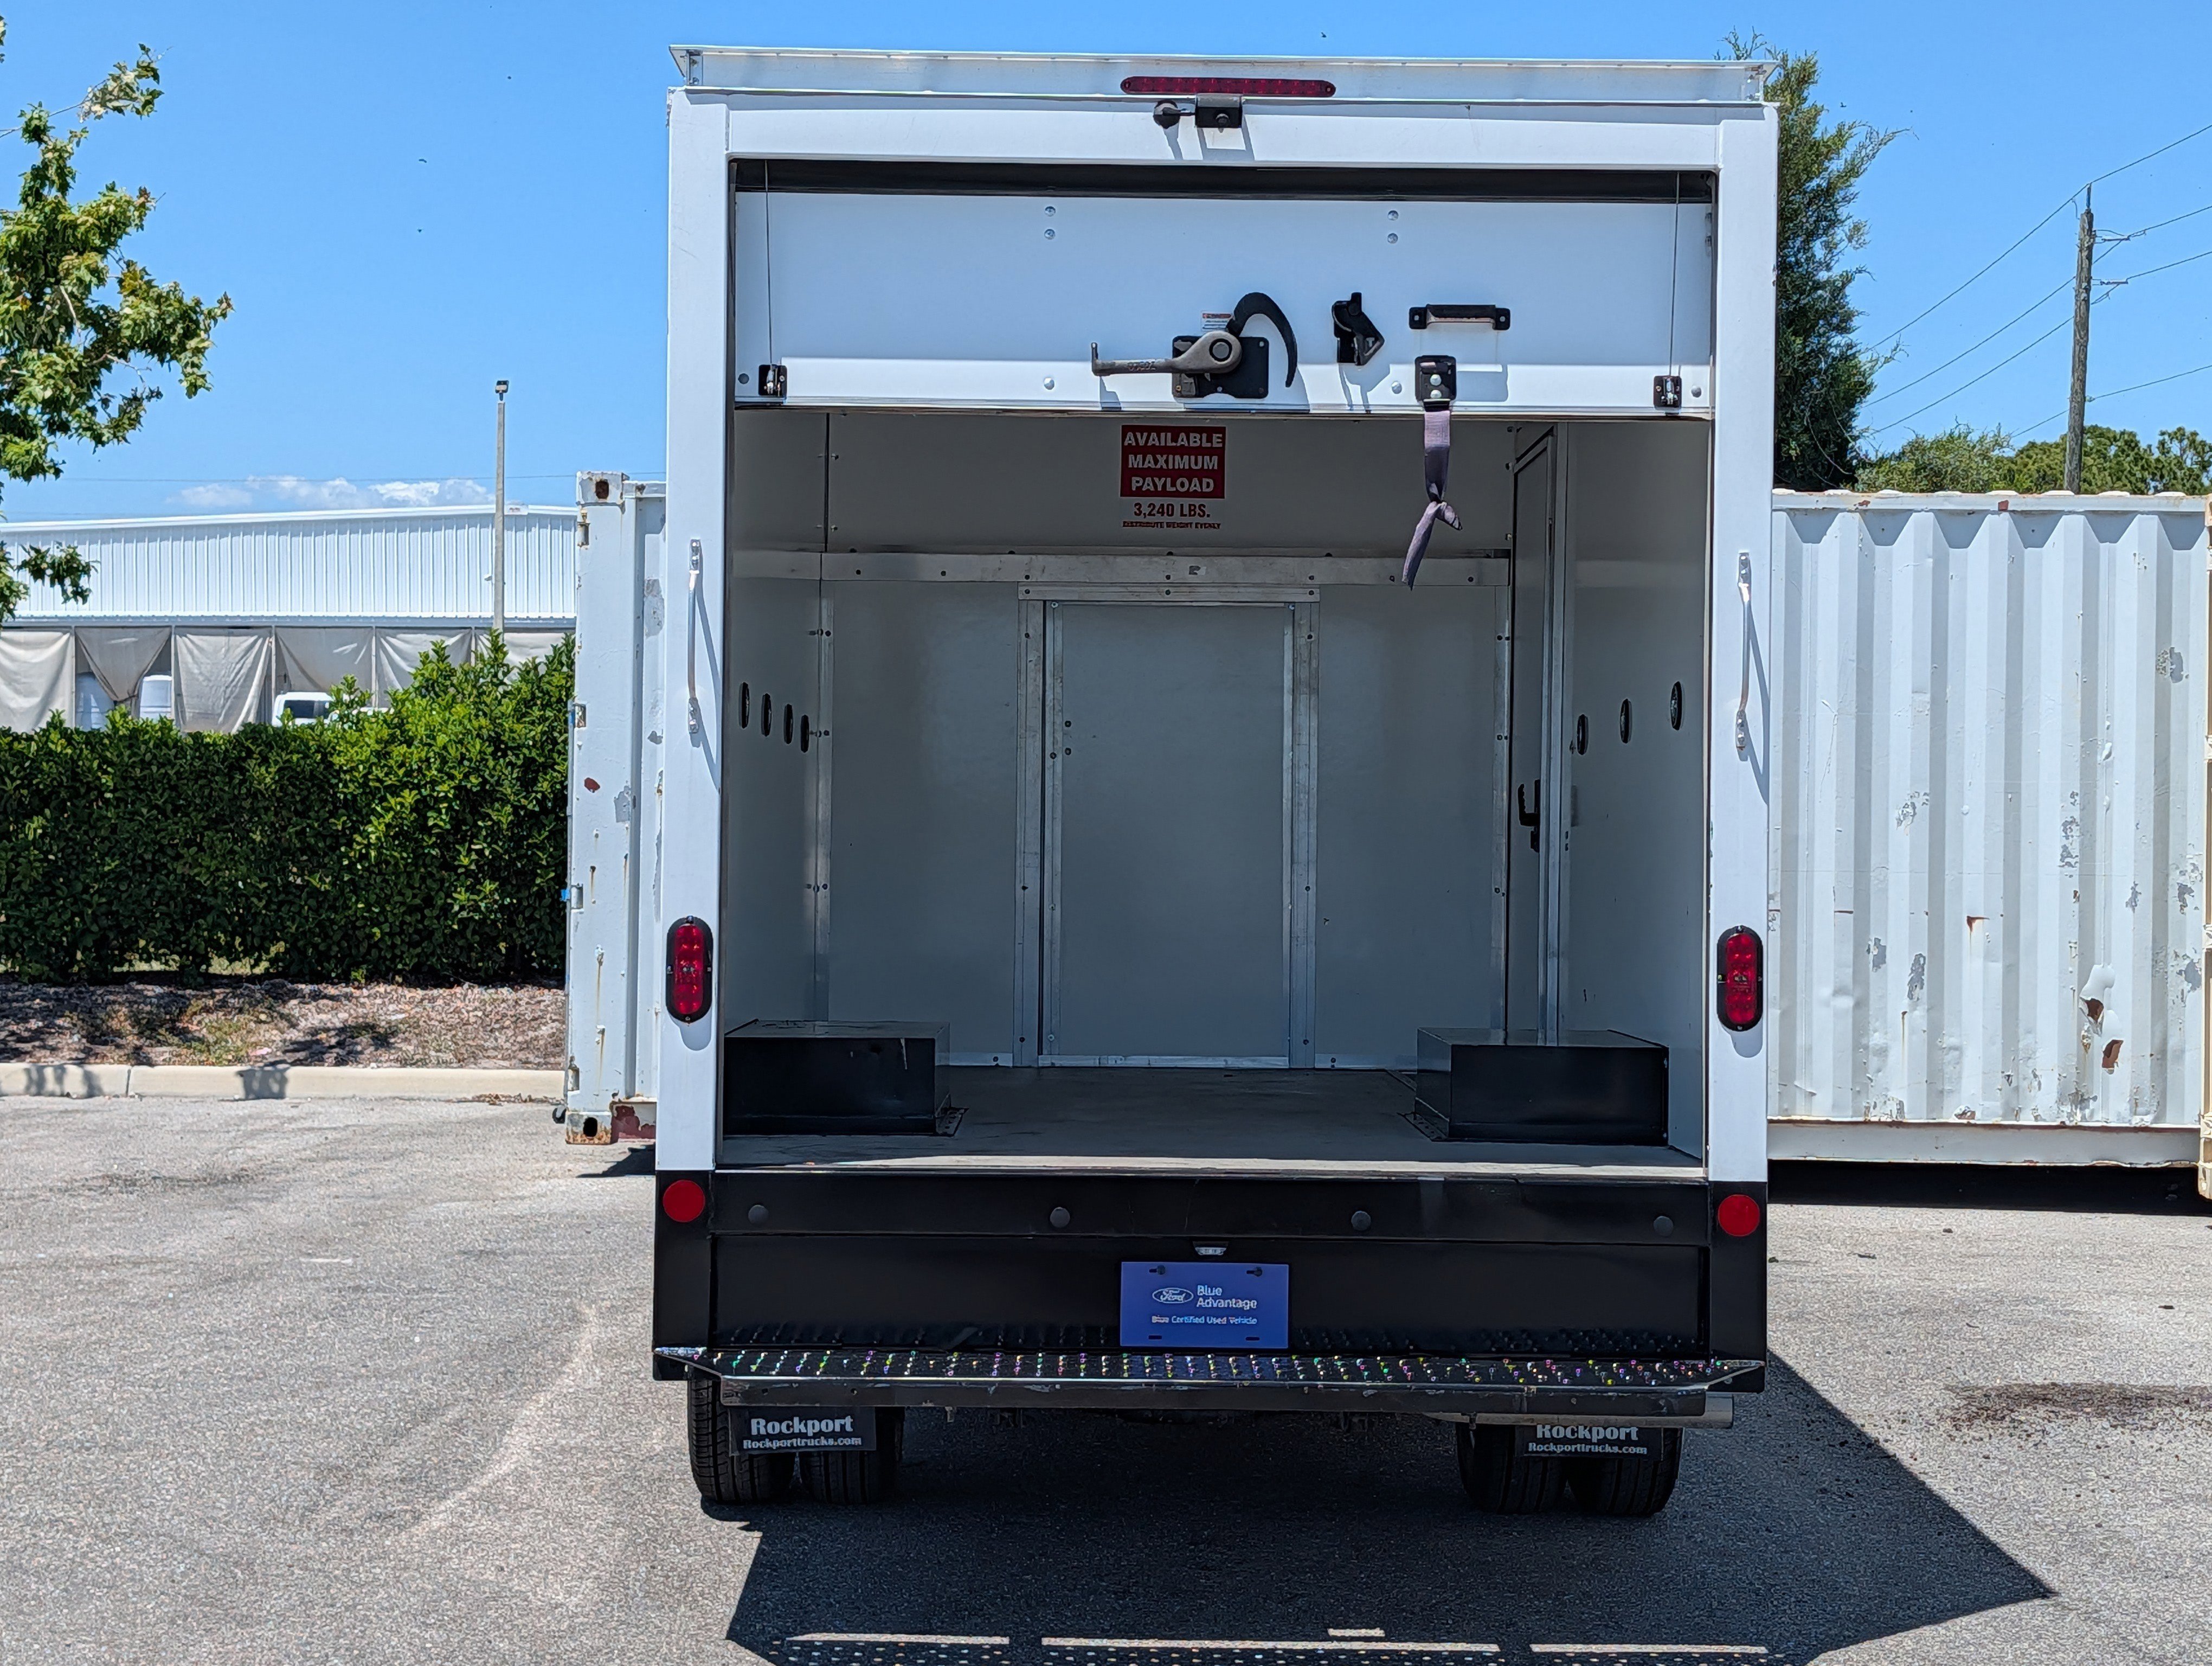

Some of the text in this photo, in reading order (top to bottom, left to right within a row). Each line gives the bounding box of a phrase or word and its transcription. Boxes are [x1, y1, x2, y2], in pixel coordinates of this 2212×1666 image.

[1124, 432, 1223, 447] AVAILABLE
[1128, 454, 1218, 470] MAXIMUM
[1131, 477, 1214, 492] PAYLOAD
[1134, 502, 1211, 518] 3,240 LBS.
[1160, 1289, 1186, 1302] Ford
[1197, 1285, 1222, 1296] Blue
[1197, 1297, 1257, 1310] Advantage
[1206, 1316, 1227, 1324] Used
[1229, 1316, 1257, 1324] Vehicle
[751, 1415, 853, 1436] Rockport
[1536, 1424, 1638, 1443] Rockport
[743, 1437, 861, 1449] Rockporttrucks.com
[1528, 1443, 1647, 1454] Rockporttrucks.com
